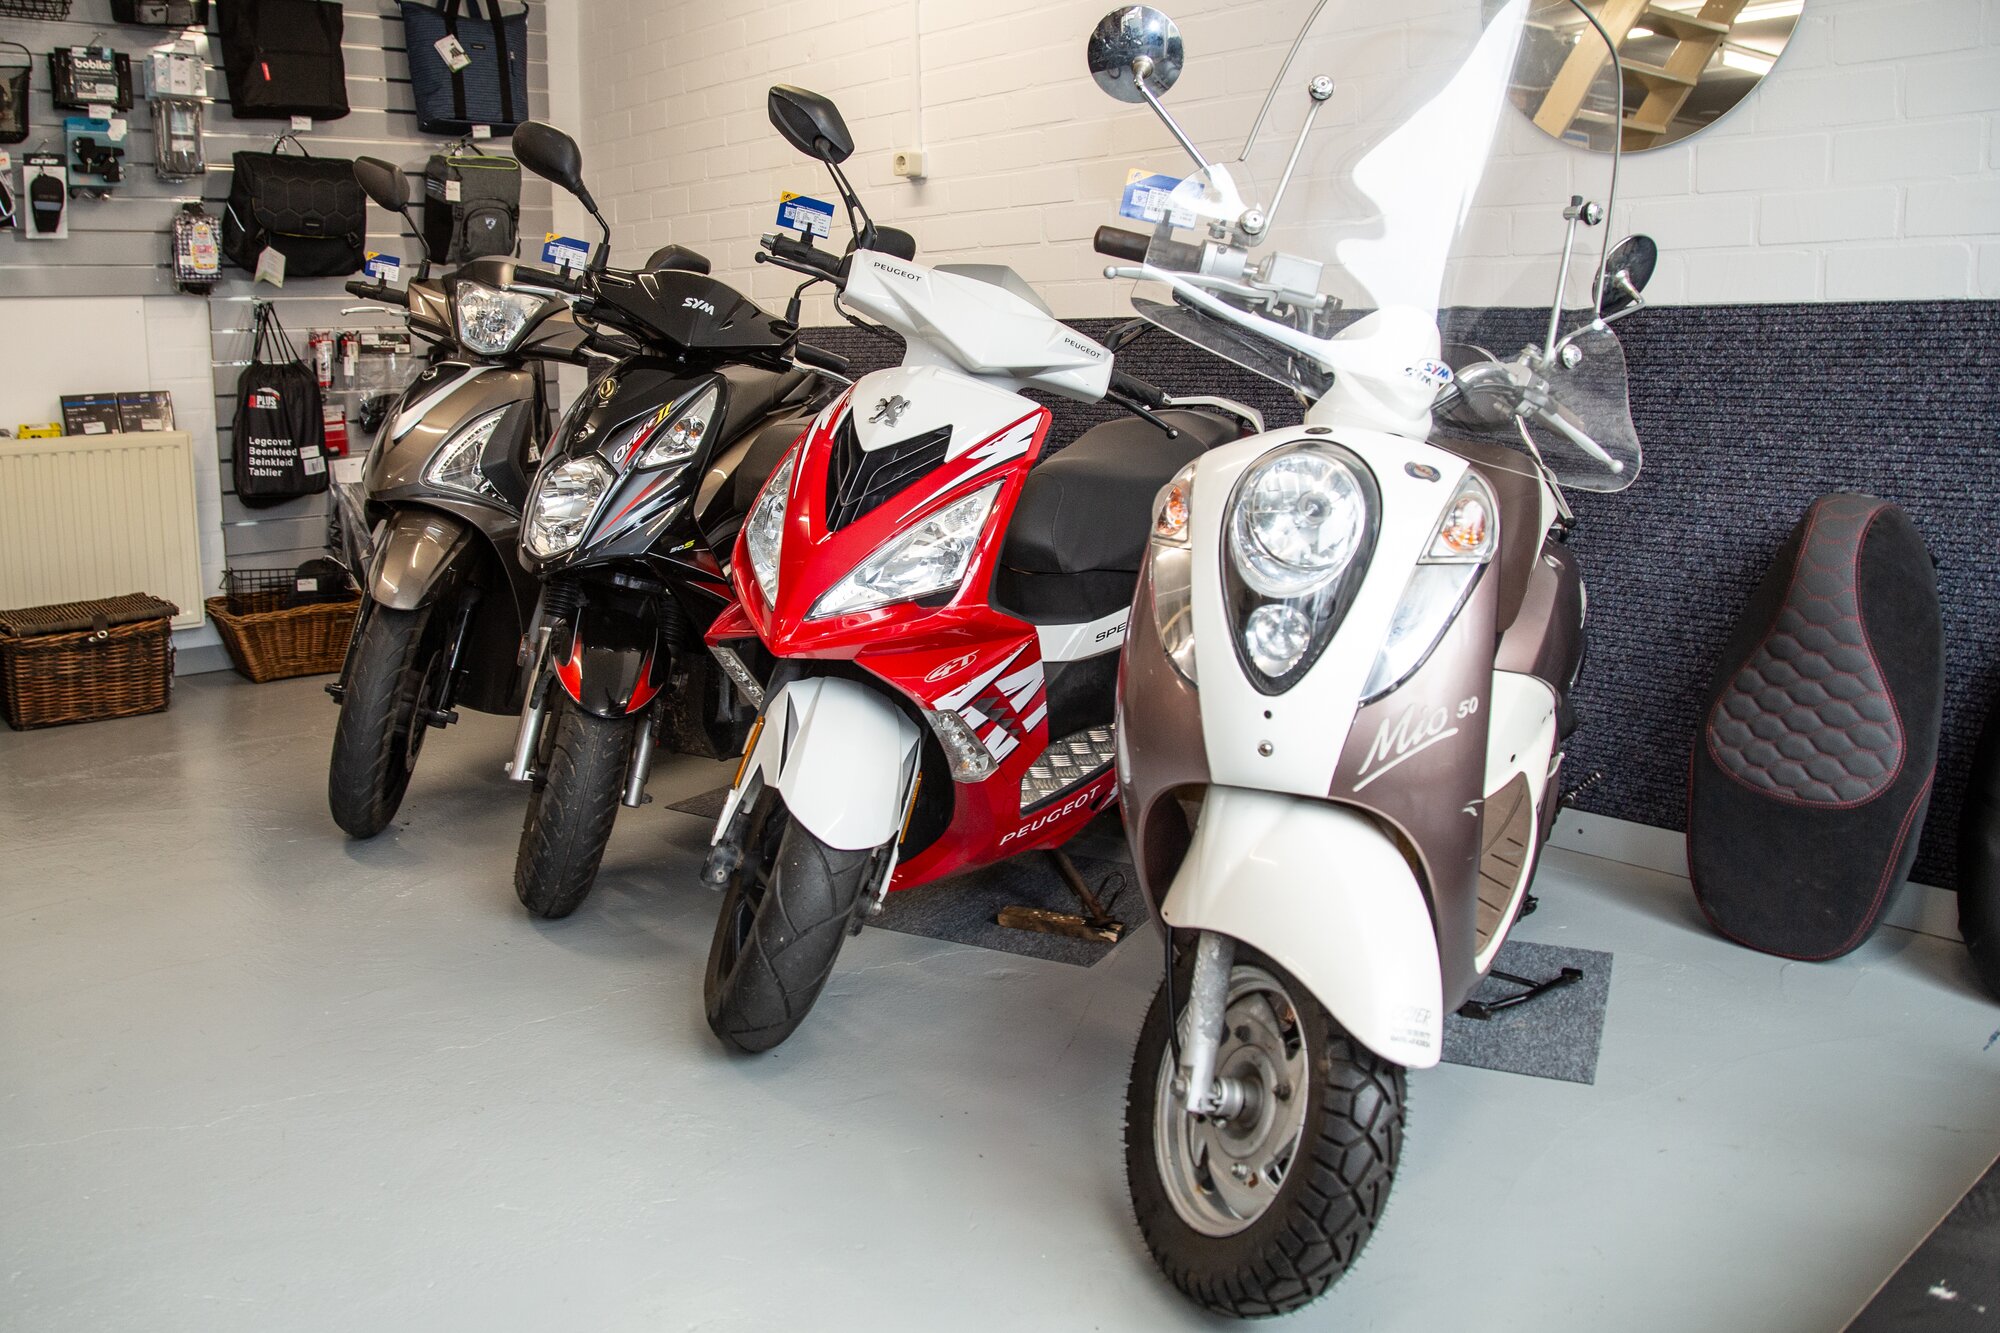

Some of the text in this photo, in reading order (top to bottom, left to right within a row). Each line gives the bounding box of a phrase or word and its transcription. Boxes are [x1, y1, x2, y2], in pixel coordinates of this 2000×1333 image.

[74, 58, 112, 70] bobike
[873, 261, 922, 281] PEUGEOT
[681, 297, 715, 316] SYM
[1064, 337, 1101, 359] PEUGEOT
[1423, 362, 1450, 380] SYM
[248, 436, 292, 446] Legcover
[248, 447, 298, 456] Beenkleed
[248, 457, 293, 467] Beinkleid
[248, 467, 283, 477] Tablier
[1095, 621, 1127, 643] SPE
[1357, 696, 1479, 776] Mio 50
[999, 784, 1101, 846] PEUGEOT
